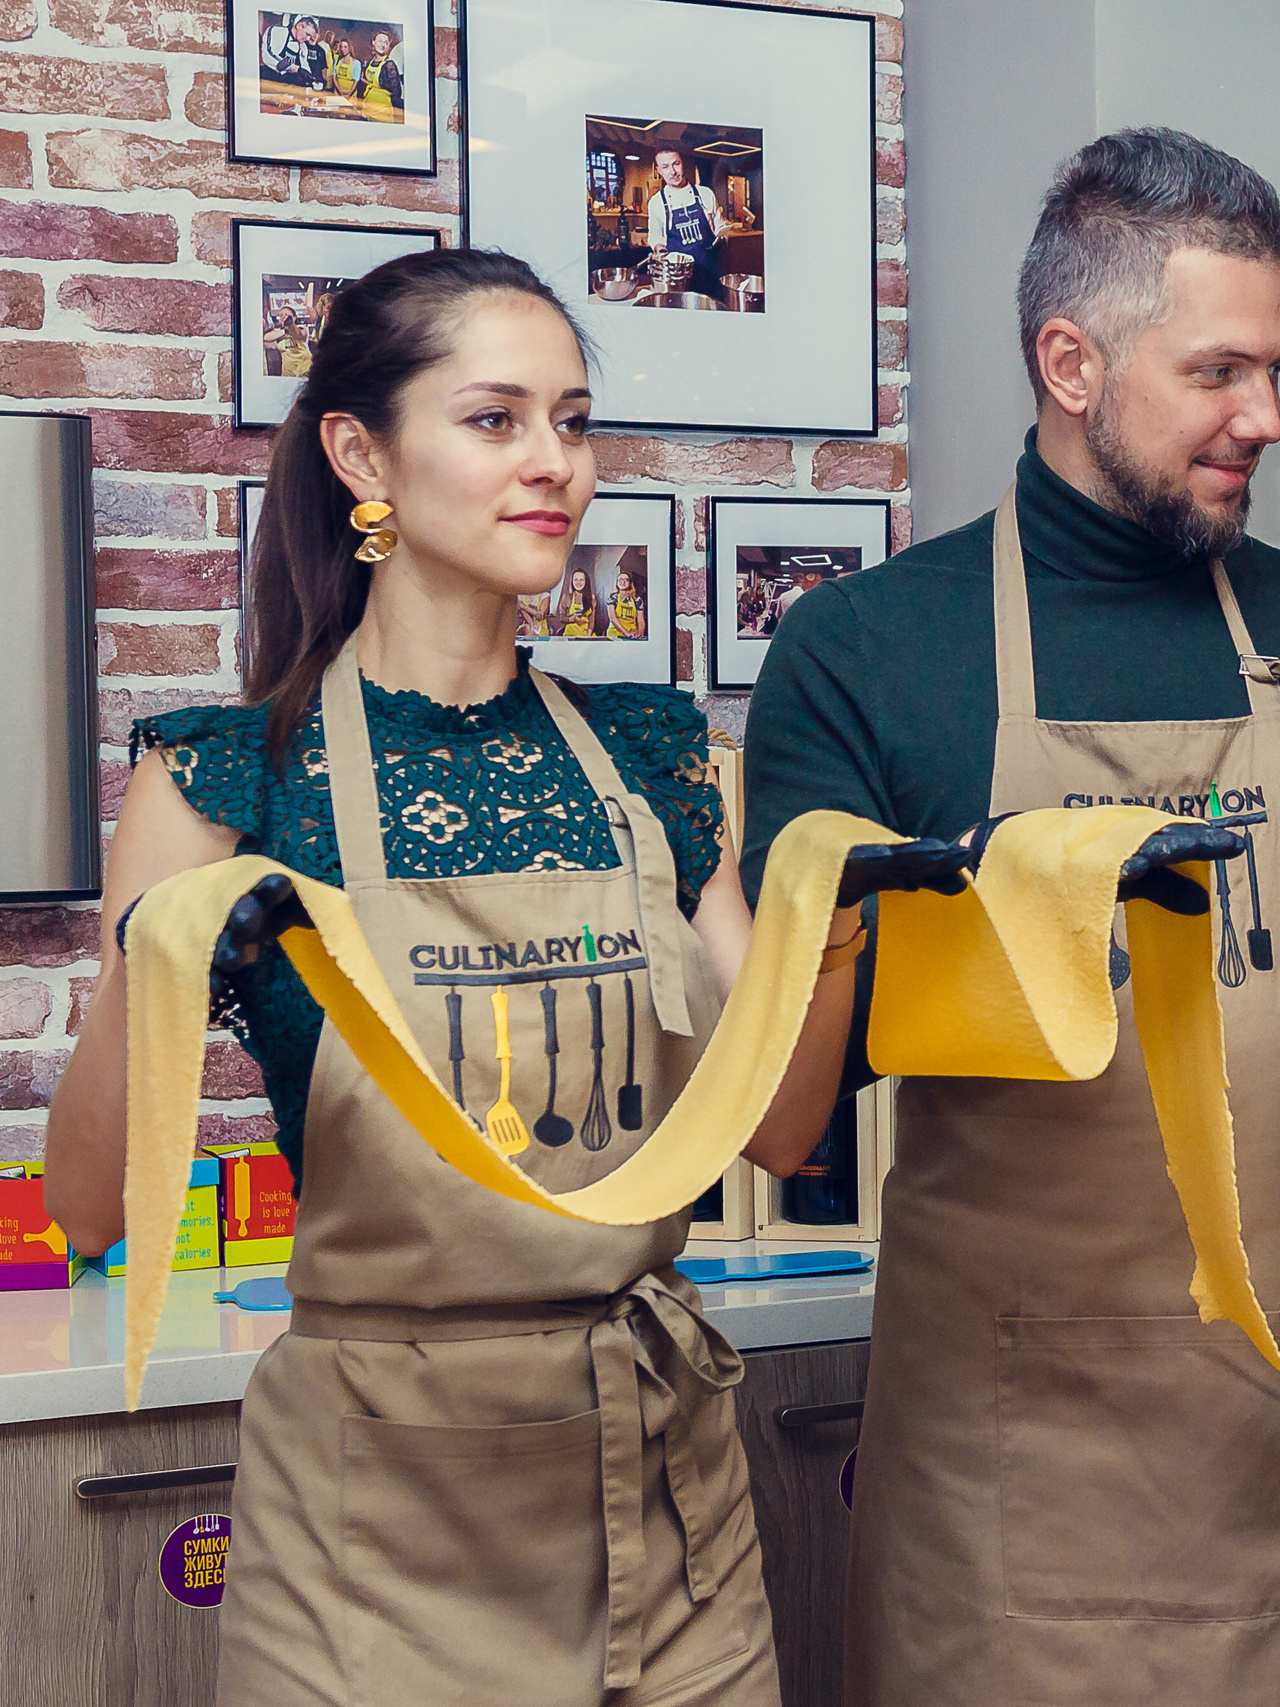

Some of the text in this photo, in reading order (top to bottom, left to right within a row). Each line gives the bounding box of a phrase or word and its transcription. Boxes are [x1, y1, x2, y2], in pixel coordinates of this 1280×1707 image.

[259, 1189, 292, 1205] Cooking
[262, 1205, 290, 1219] is love
[263, 1221, 286, 1234] made
[175, 1232, 191, 1244] not
[174, 1247, 211, 1261] calories
[184, 1536, 229, 1555] СУМКИ
